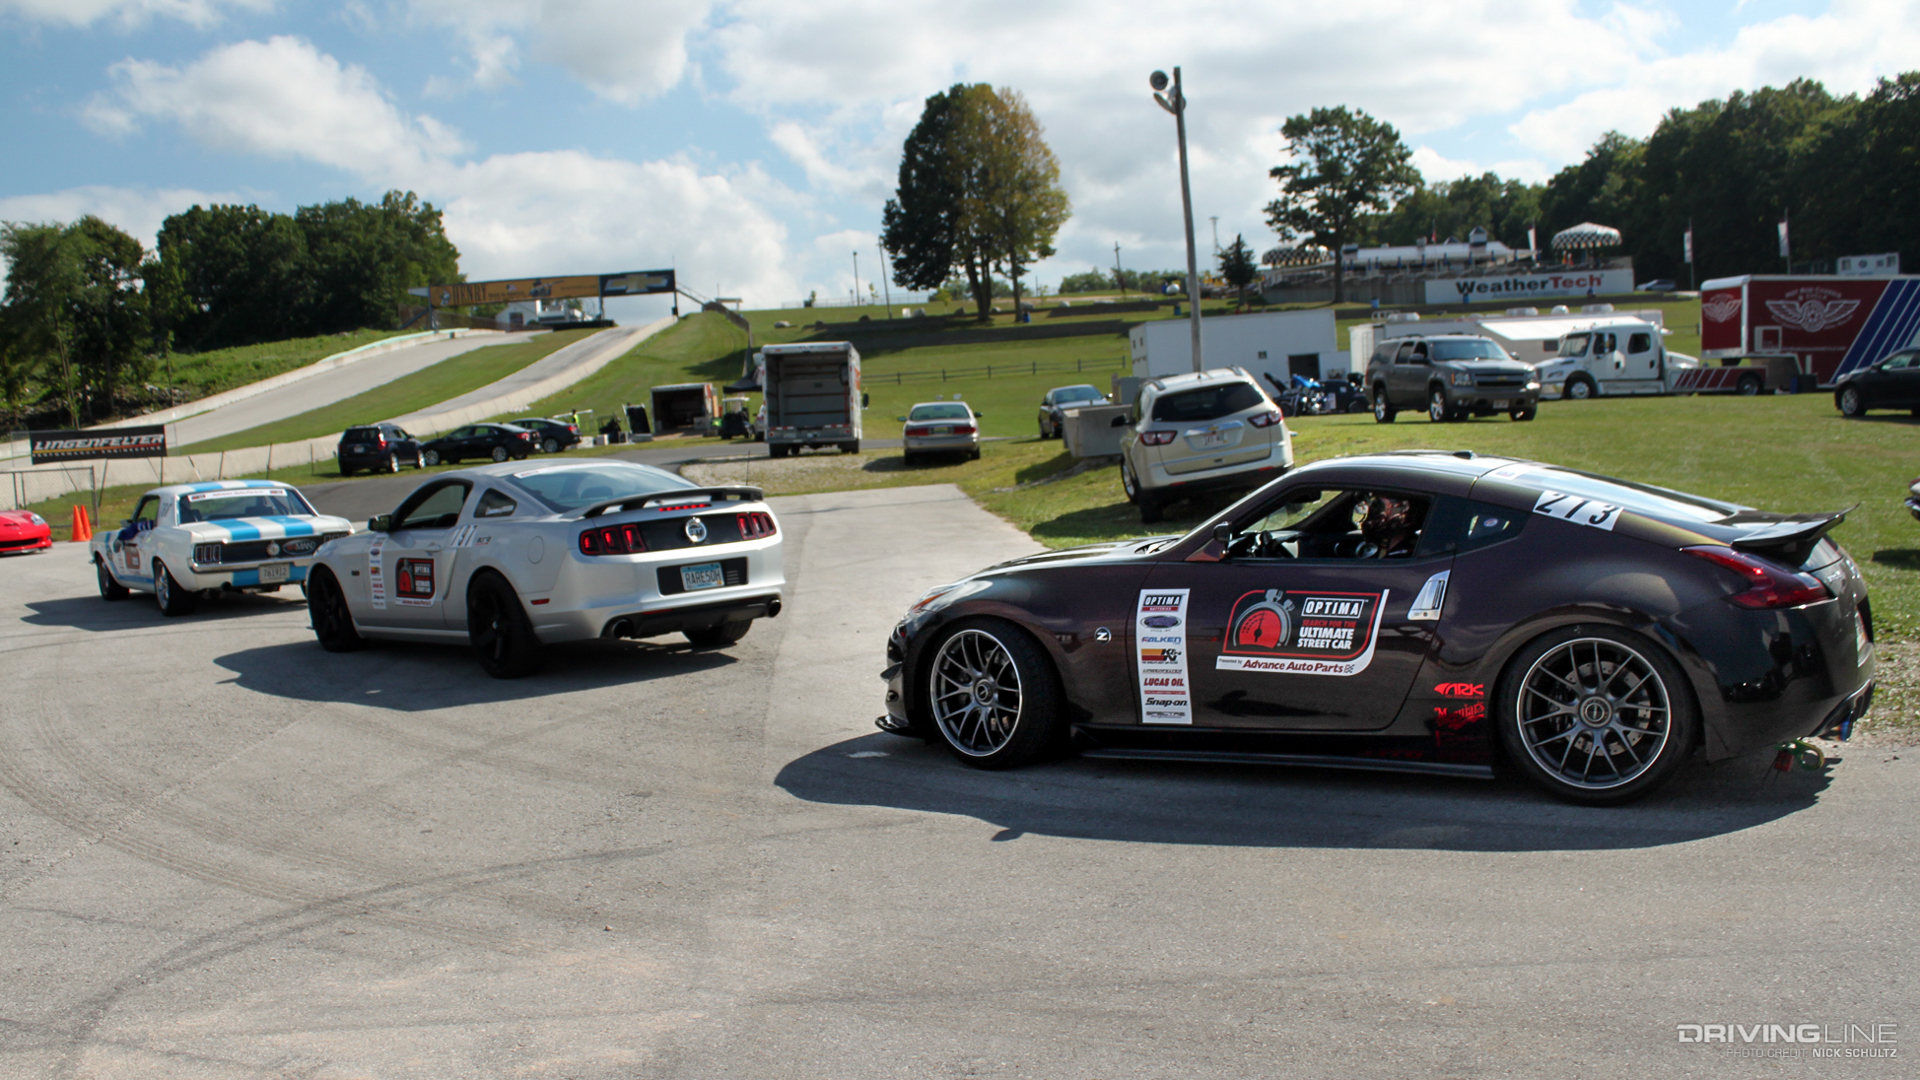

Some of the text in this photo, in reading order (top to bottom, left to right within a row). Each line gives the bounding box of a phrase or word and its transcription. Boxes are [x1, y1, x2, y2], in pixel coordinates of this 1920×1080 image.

[1456, 274, 1602, 294] WeatherTech
[452, 283, 487, 305] HENRY
[33, 434, 165, 451] LINGENFELTER
[1145, 596, 1180, 606] OPTIMA
[1305, 600, 1360, 616] OPTIMA
[1302, 619, 1329, 627] SEARCH
[1096, 632, 1108, 641] Z
[1299, 626, 1355, 640] ULTIMATE
[1297, 639, 1353, 650] STREET CAR
[1243, 659, 1285, 671] Advance
[1286, 661, 1313, 672] Auto
[1314, 662, 1343, 673] Parts
[1144, 678, 1185, 687] LUCAS OIL
